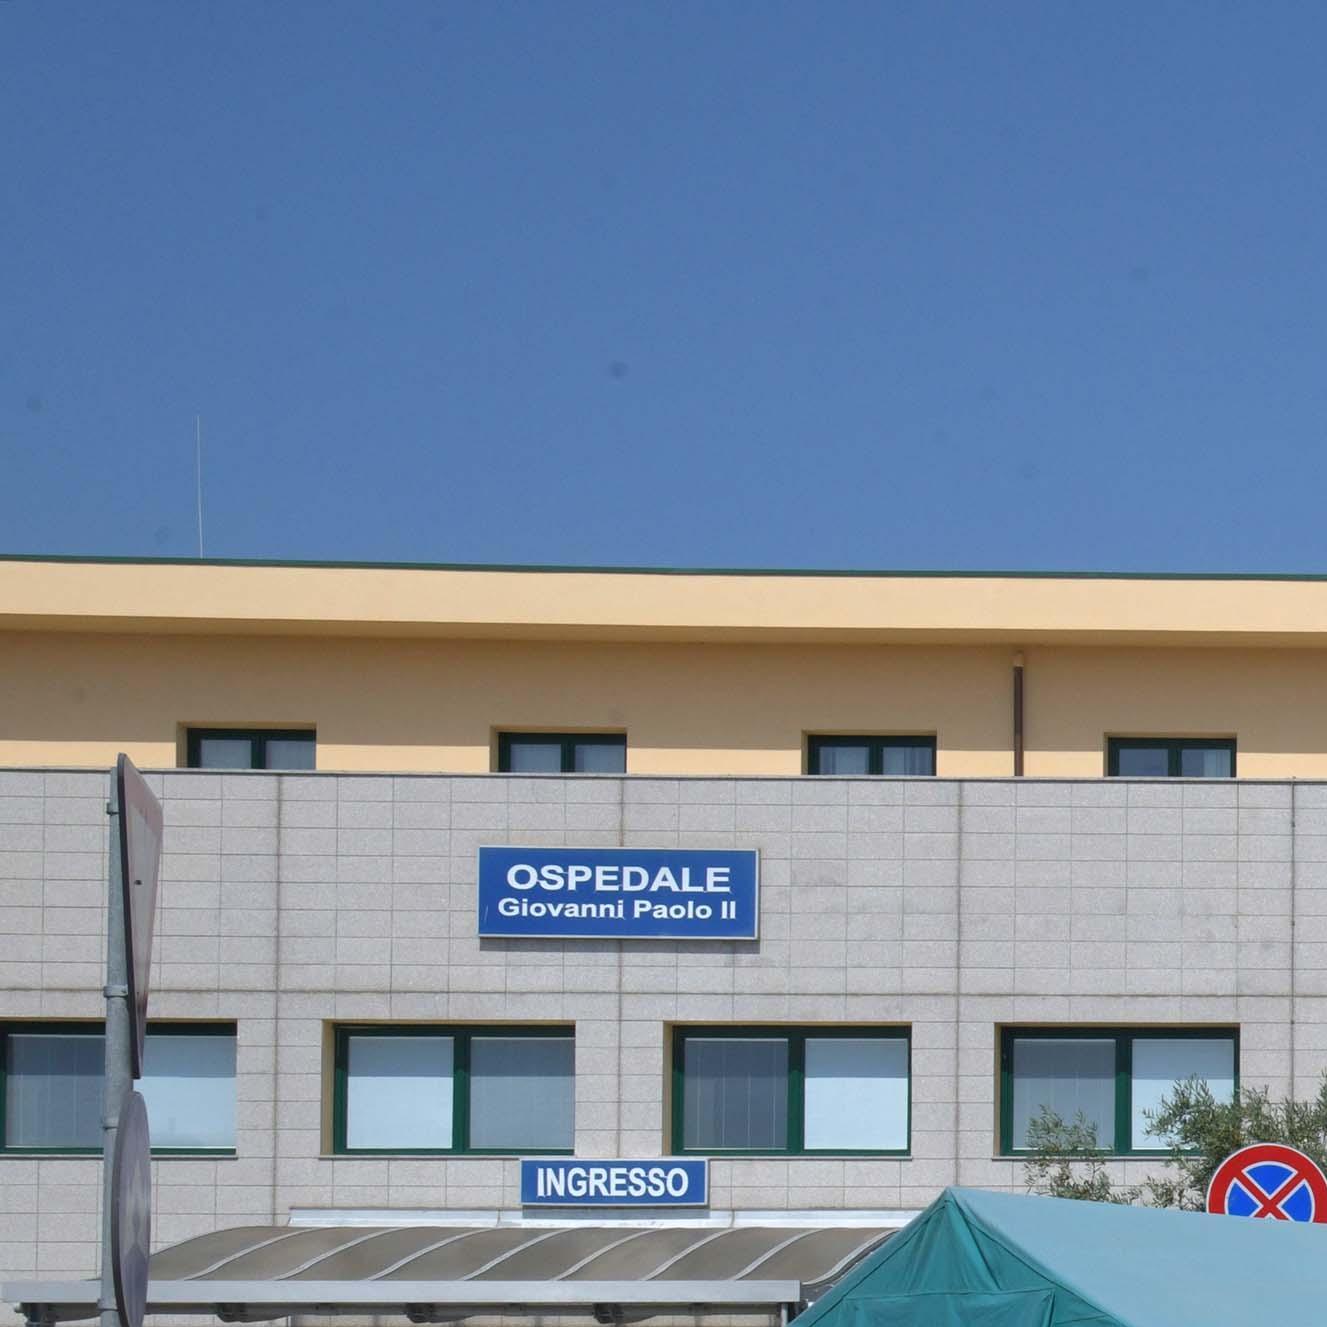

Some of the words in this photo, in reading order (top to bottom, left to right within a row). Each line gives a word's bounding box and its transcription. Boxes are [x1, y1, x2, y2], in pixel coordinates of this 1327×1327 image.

[506, 864, 731, 893] OSPEDALE
[498, 897, 625, 919] Giovanni
[634, 900, 713, 919] Paolo
[721, 901, 736, 919] II
[537, 1167, 689, 1197] INGRESSO
